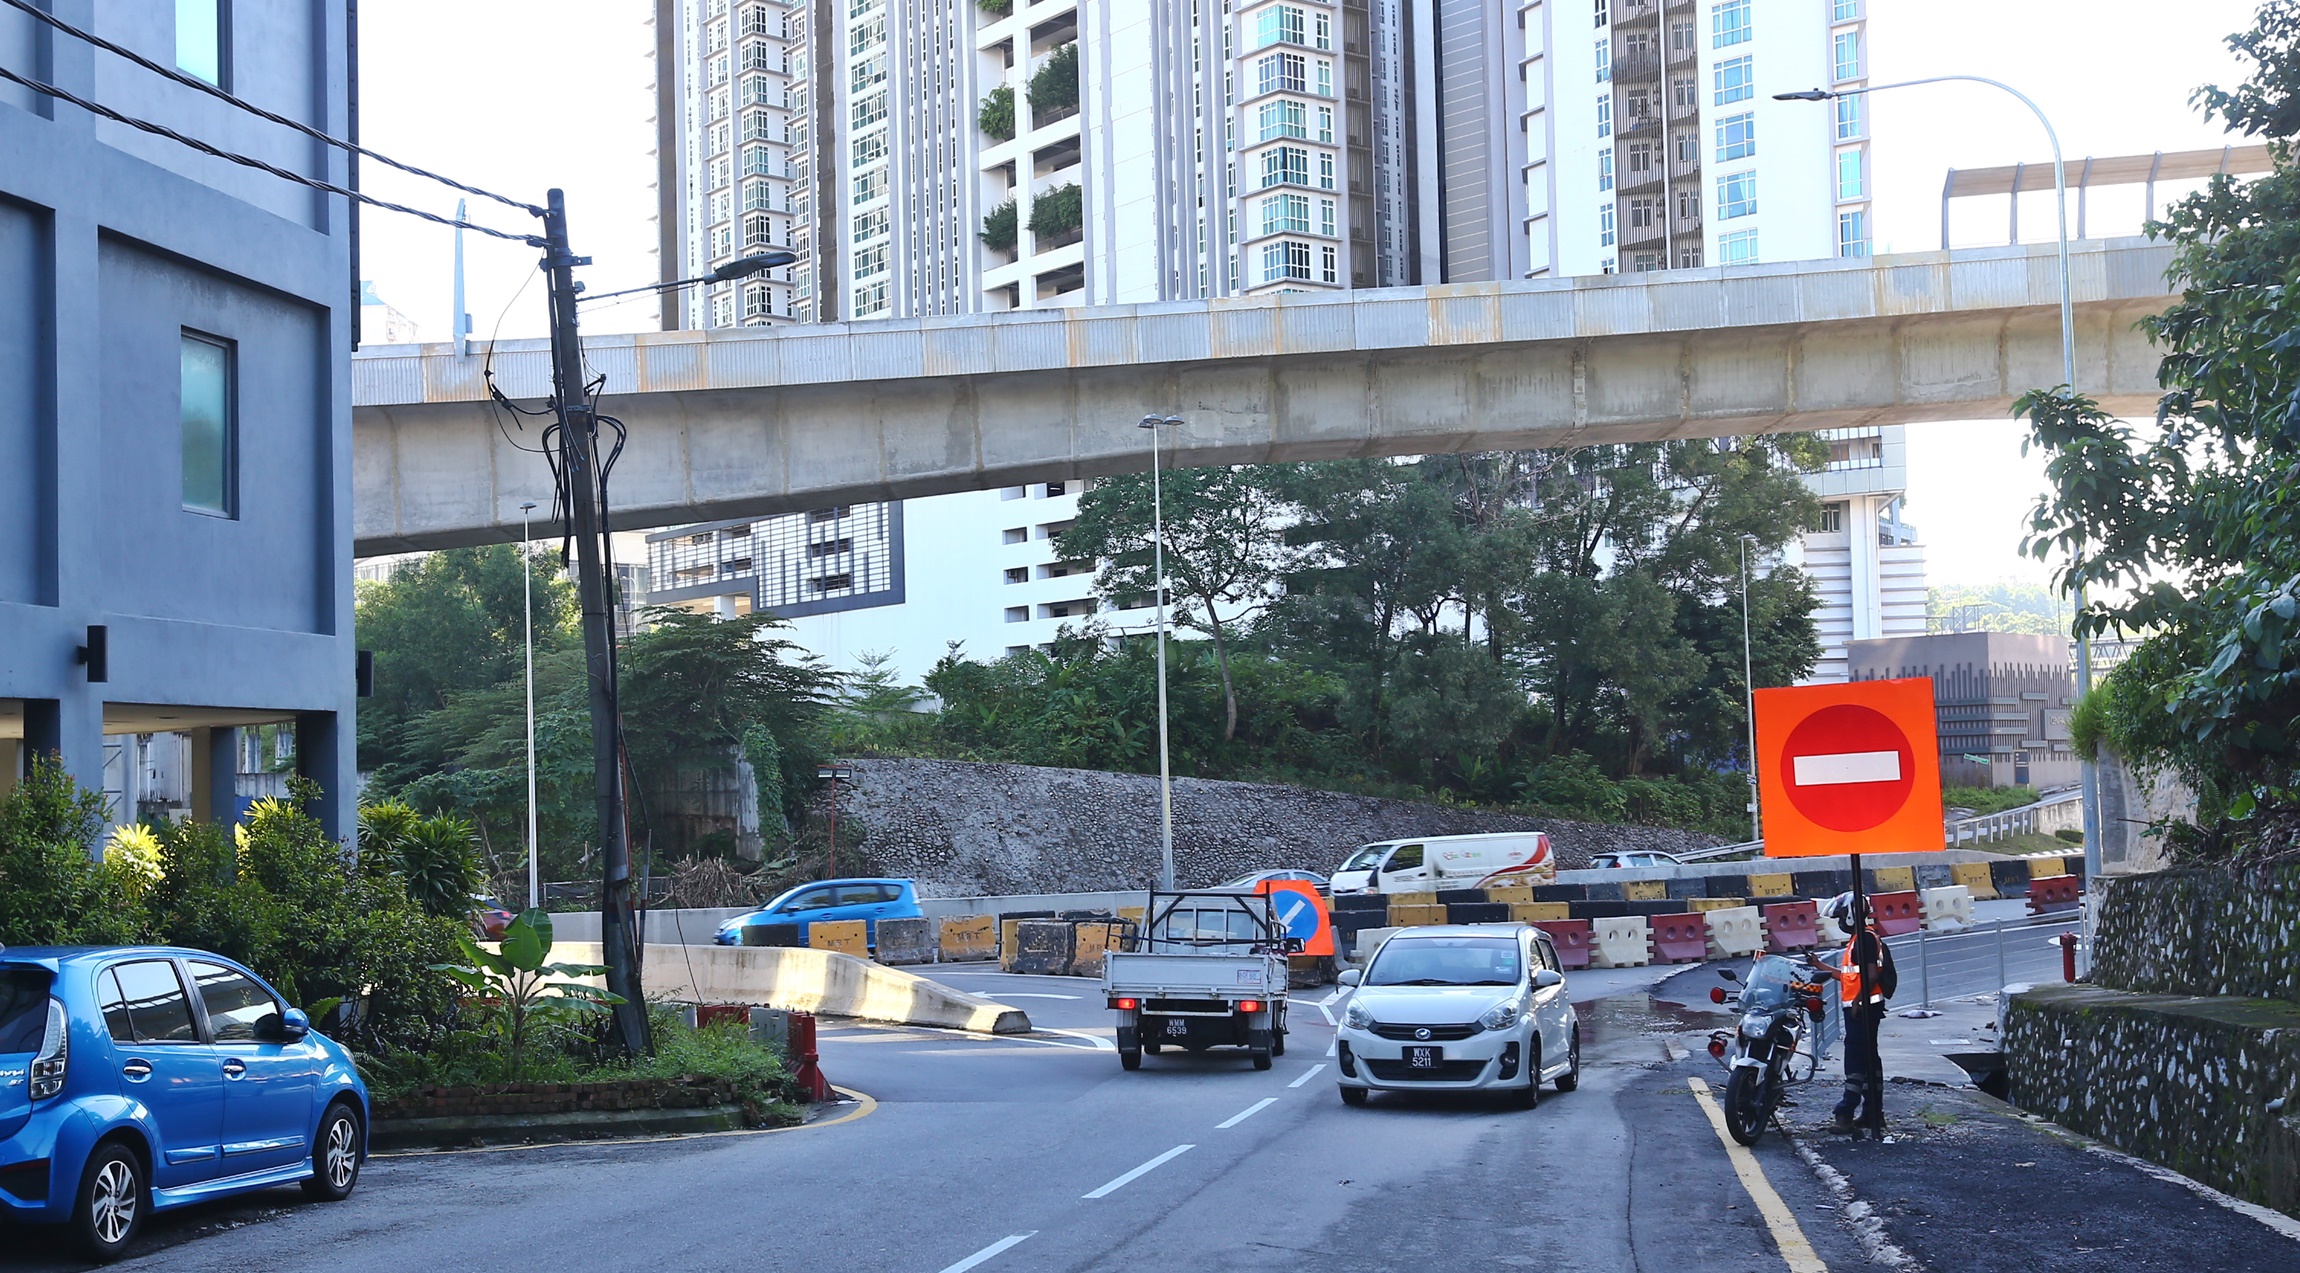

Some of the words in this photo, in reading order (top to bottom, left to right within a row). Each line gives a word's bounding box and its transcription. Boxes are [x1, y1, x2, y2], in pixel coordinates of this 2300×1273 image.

[1764, 887, 1782, 895] MRT
[957, 931, 980, 941] MRT
[827, 938, 851, 948] MRT
[1168, 1018, 1185, 1026] WMM
[1166, 1026, 1187, 1035] 6539
[1413, 1047, 1431, 1057] WXK
[1412, 1056, 1431, 1067] 5211
